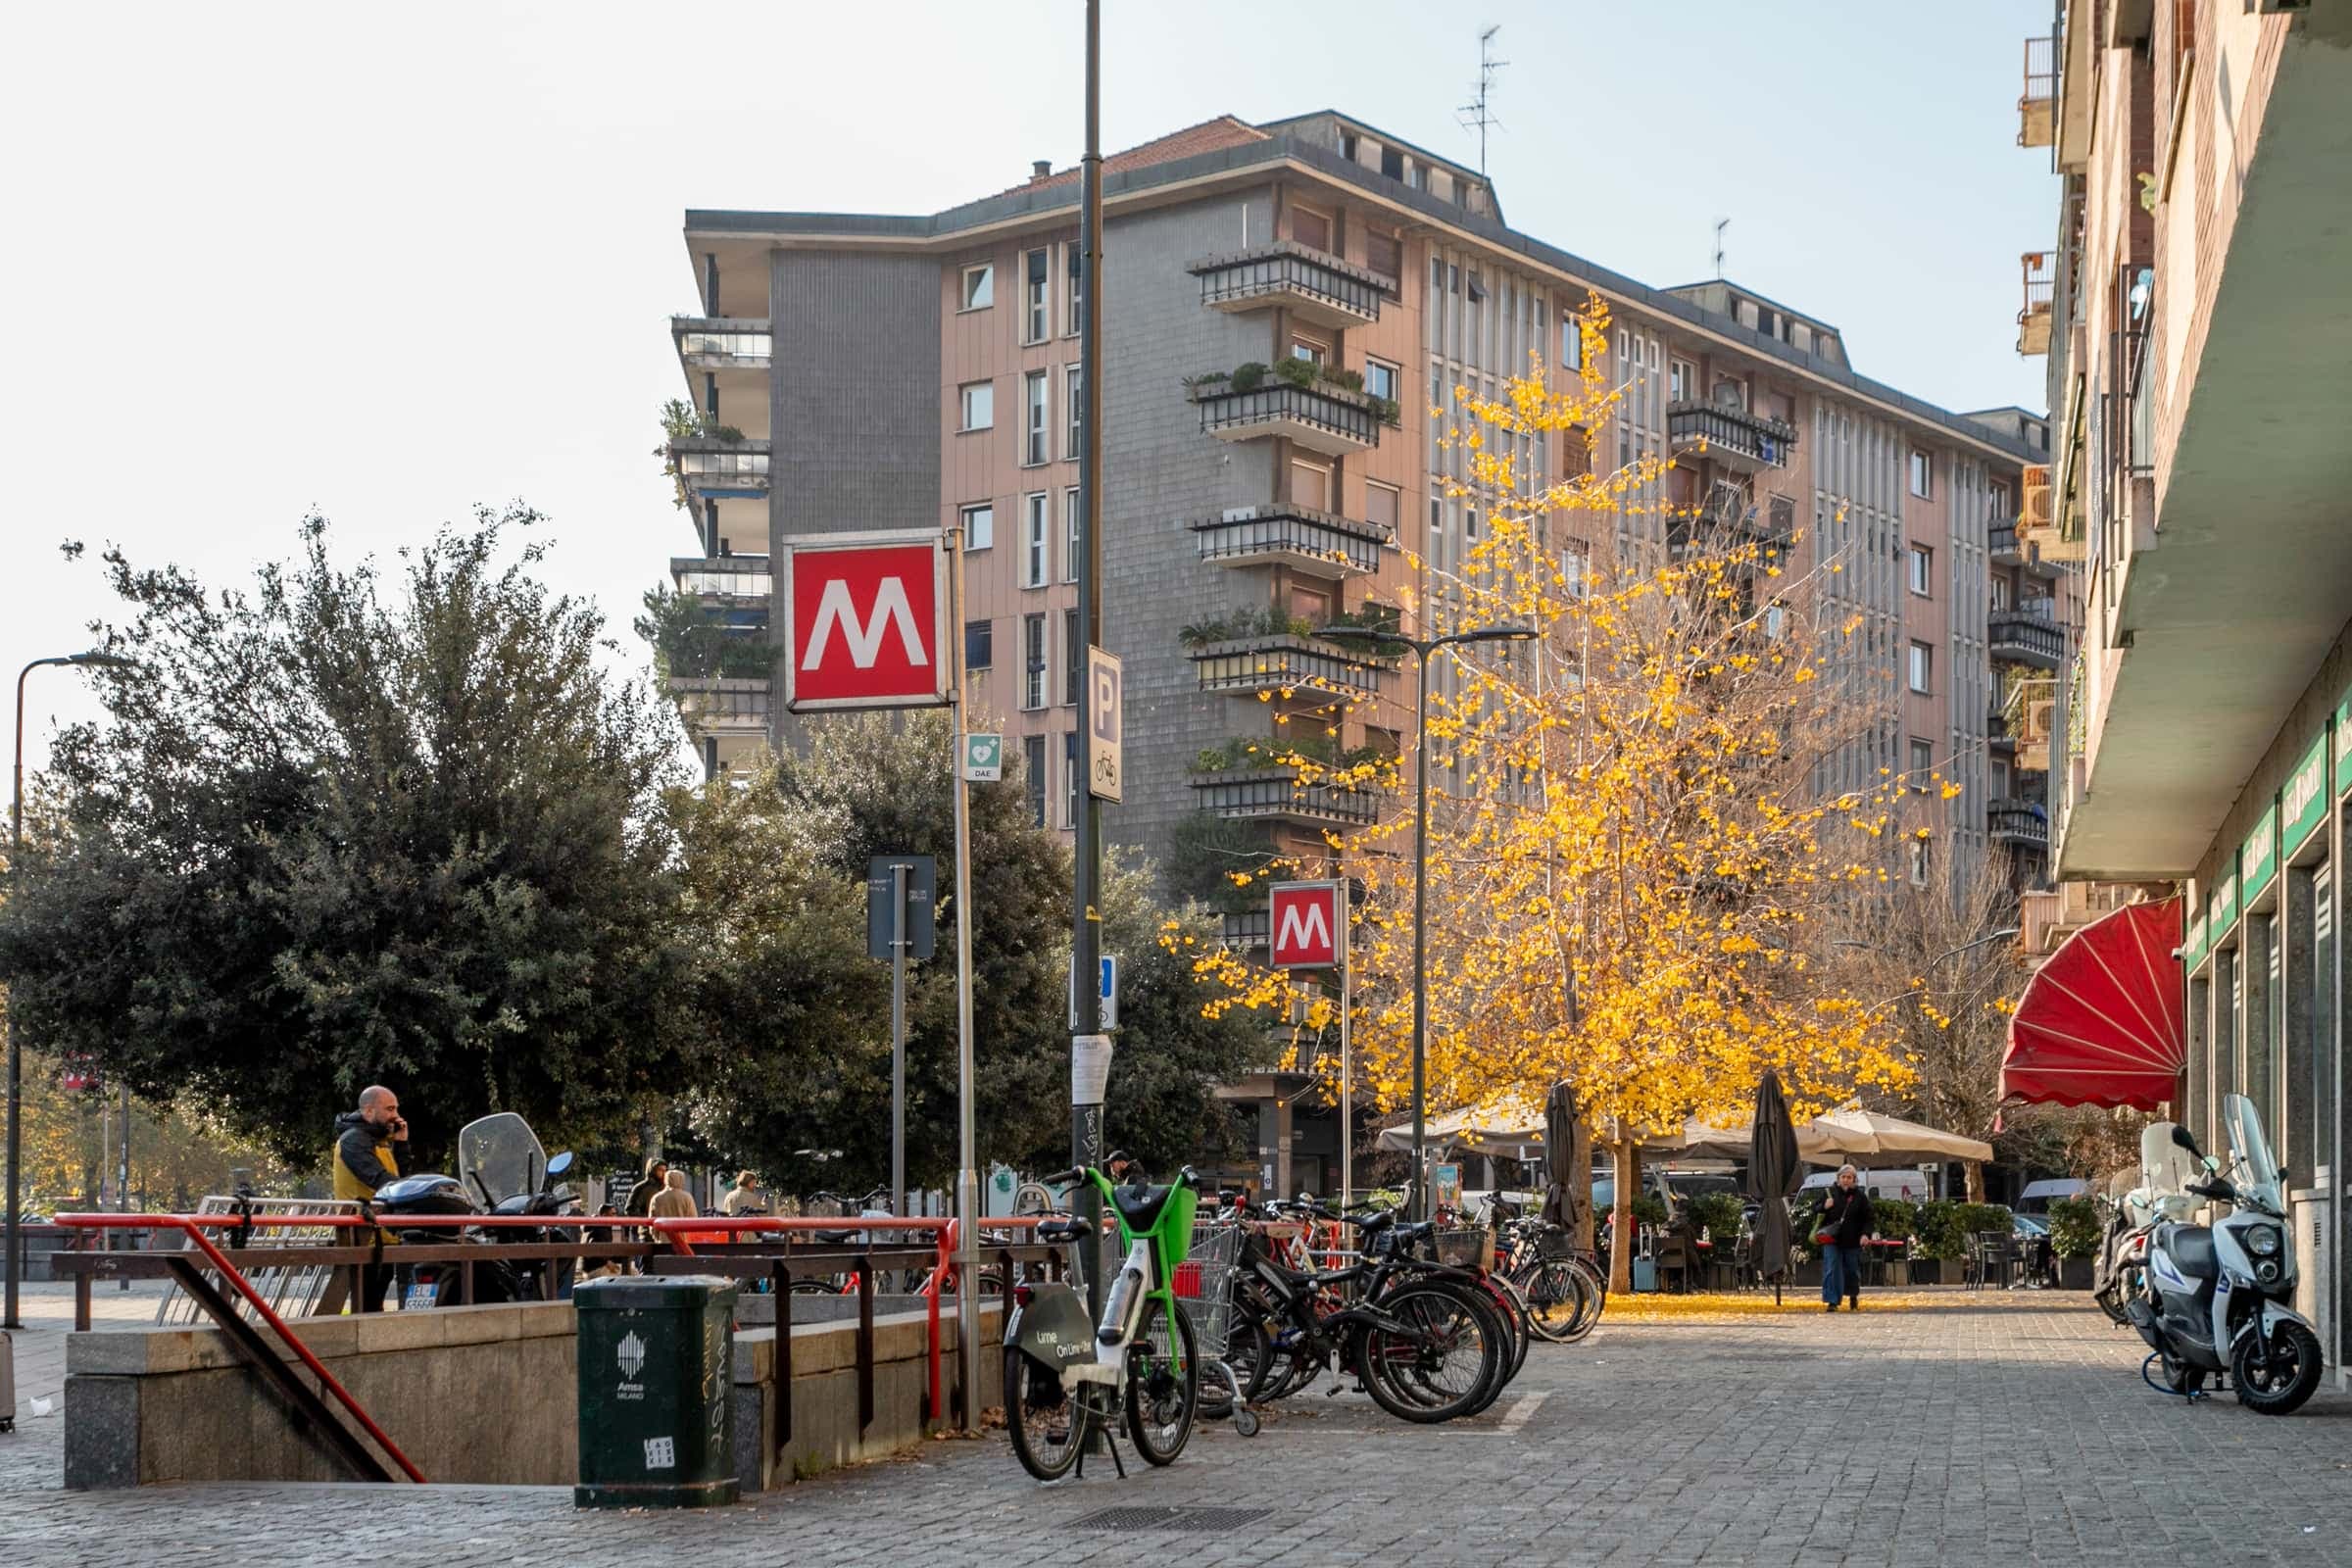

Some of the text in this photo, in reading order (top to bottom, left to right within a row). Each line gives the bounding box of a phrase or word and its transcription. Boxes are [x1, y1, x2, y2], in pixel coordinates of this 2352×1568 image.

[801, 575, 929, 671] M
[1098, 671, 1113, 730] P
[1276, 903, 1332, 951] M
[1036, 1332, 1057, 1344] Lime
